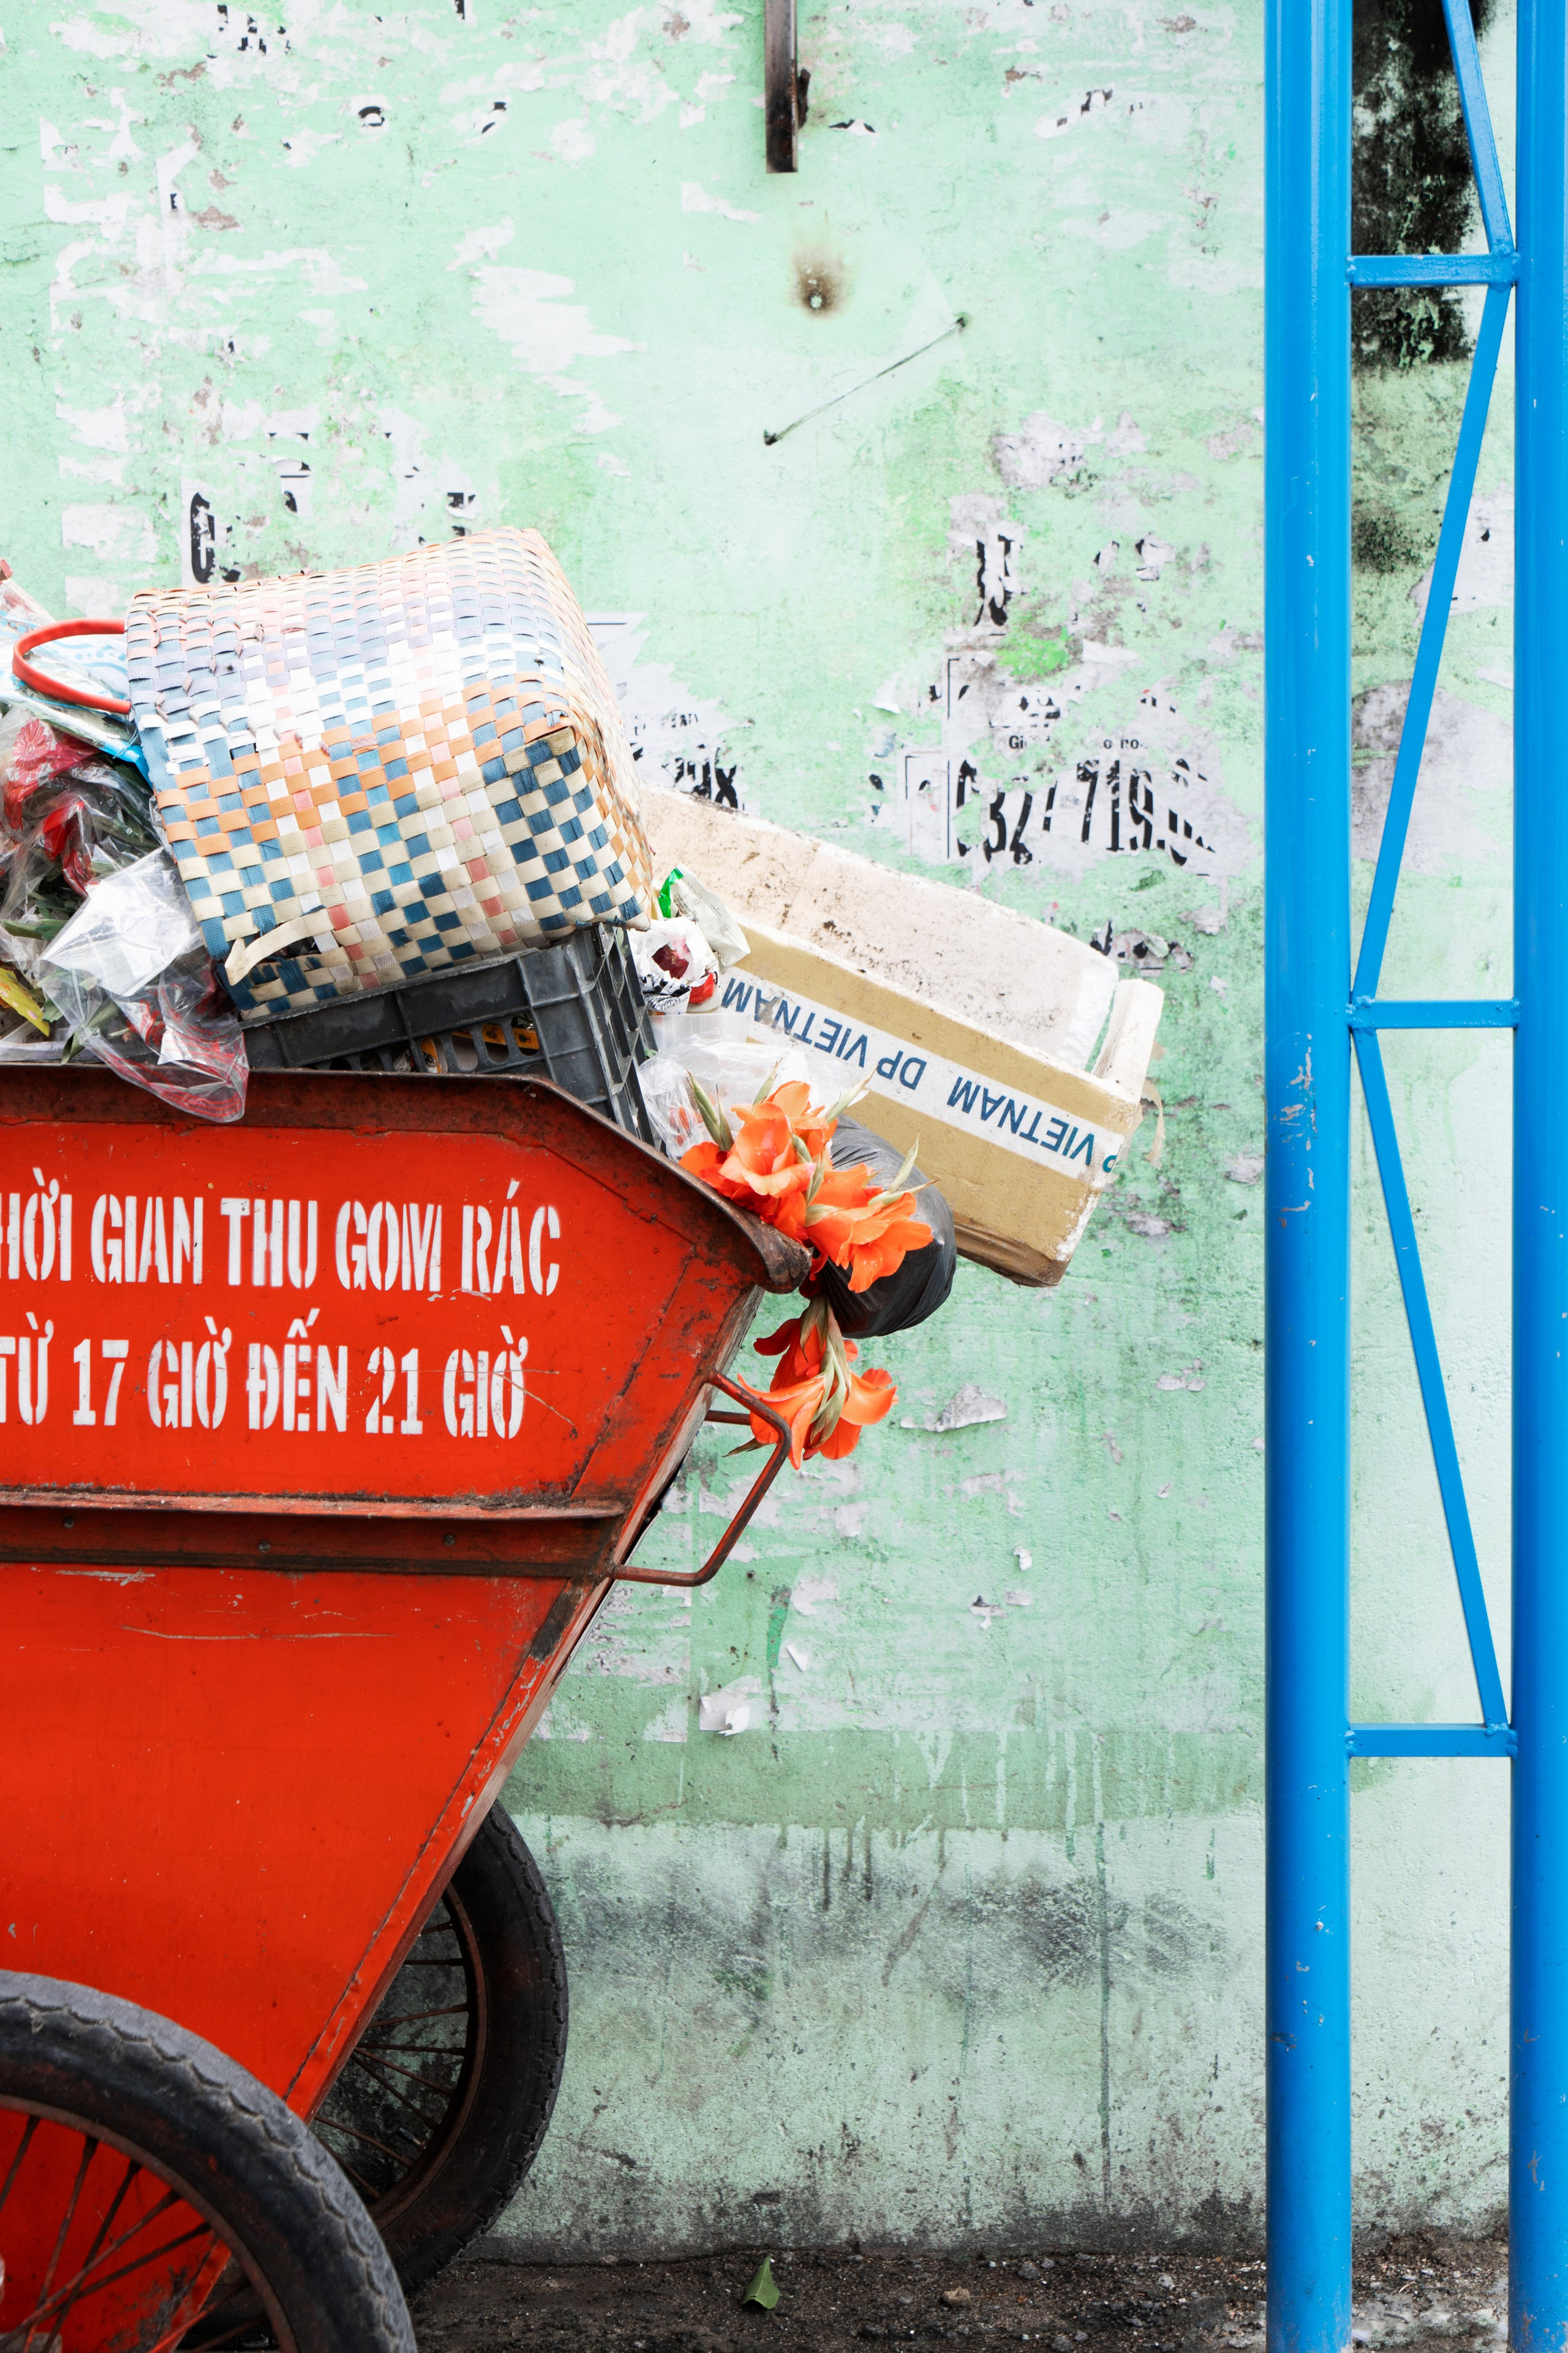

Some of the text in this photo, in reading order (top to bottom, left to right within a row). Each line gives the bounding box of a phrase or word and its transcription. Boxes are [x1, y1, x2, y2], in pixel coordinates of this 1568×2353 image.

[721, 977, 1095, 1166] VIETNAM DP VIETNAM
[91, 1194, 203, 1284] GIAN
[221, 1198, 318, 1289] THU
[334, 1201, 442, 1292] GOM
[461, 1179, 561, 1296] RÁC
[73, 1339, 129, 1426] 17
[147, 1315, 232, 1429] GIỜ
[246, 1307, 348, 1432] ĐẾN
[366, 1346, 423, 1435] 21
[443, 1324, 529, 1440] GIỜ
